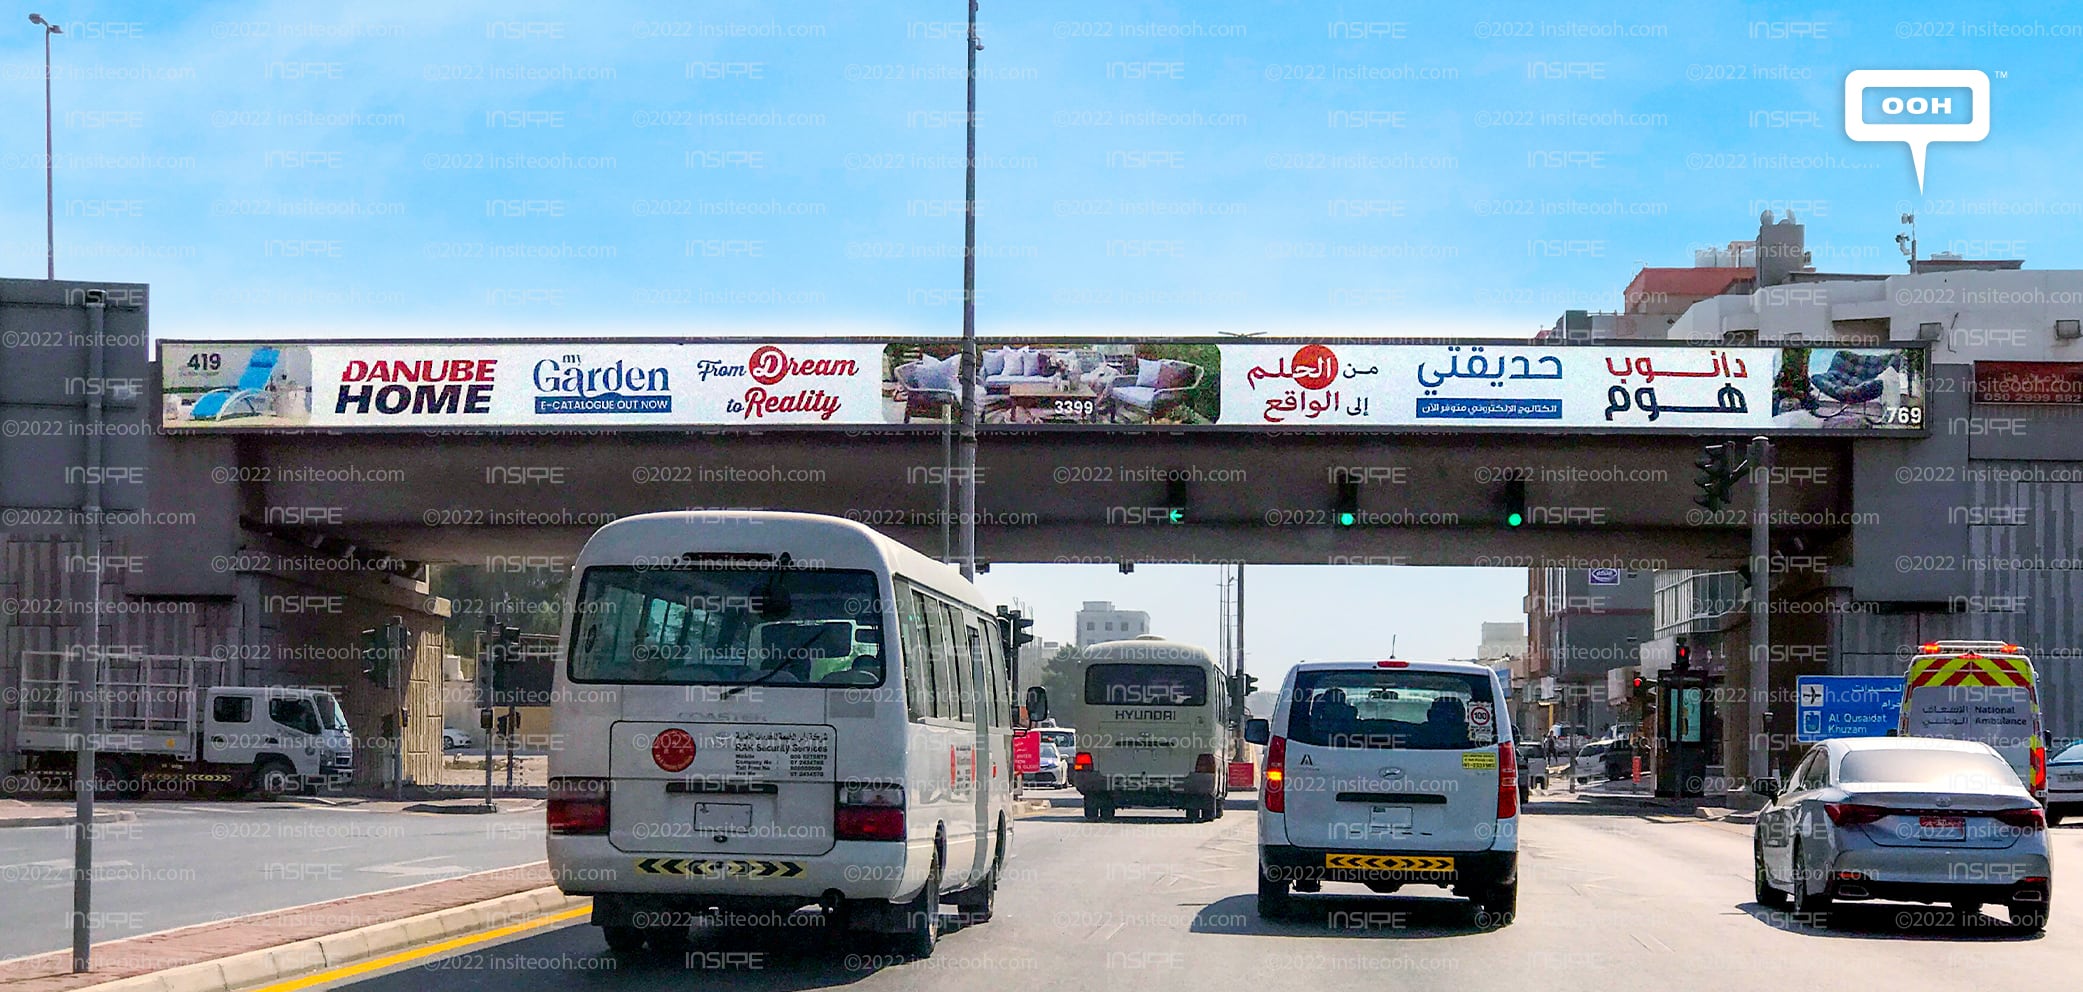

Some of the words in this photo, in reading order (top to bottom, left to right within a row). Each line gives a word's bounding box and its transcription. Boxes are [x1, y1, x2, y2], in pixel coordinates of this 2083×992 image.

[187, 353, 221, 371] 419
[341, 359, 498, 382] DANUBE
[697, 358, 747, 382] From
[752, 347, 859, 378] Dream
[1342, 363, 1379, 379] من
[1417, 345, 1563, 396] حديقتي
[1605, 350, 1748, 384] دانوب
[533, 357, 671, 397] Garden
[1246, 353, 1332, 390] الحلم
[334, 385, 494, 414] HOME
[541, 400, 615, 411] E-CATALOGUE
[618, 400, 638, 411] OUT
[641, 400, 668, 411] NOW
[727, 398, 744, 413] to
[744, 387, 841, 420] Reality
[1054, 400, 1094, 415] 3399
[1263, 390, 1340, 422] الواقع
[1346, 397, 1369, 416] إلى
[1605, 382, 1748, 422] هوم
[1886, 406, 1922, 424] 769
[1115, 710, 1176, 720] HYUNDAI
[1474, 712, 1487, 720] 100
[1828, 713, 1840, 722] Al
[1843, 713, 1887, 723] Qusaidat
[1975, 705, 2015, 714] National
[1828, 725, 1867, 734] Khuzam
[1975, 716, 2028, 726] Ambulance
[735, 743, 754, 752] RAK
